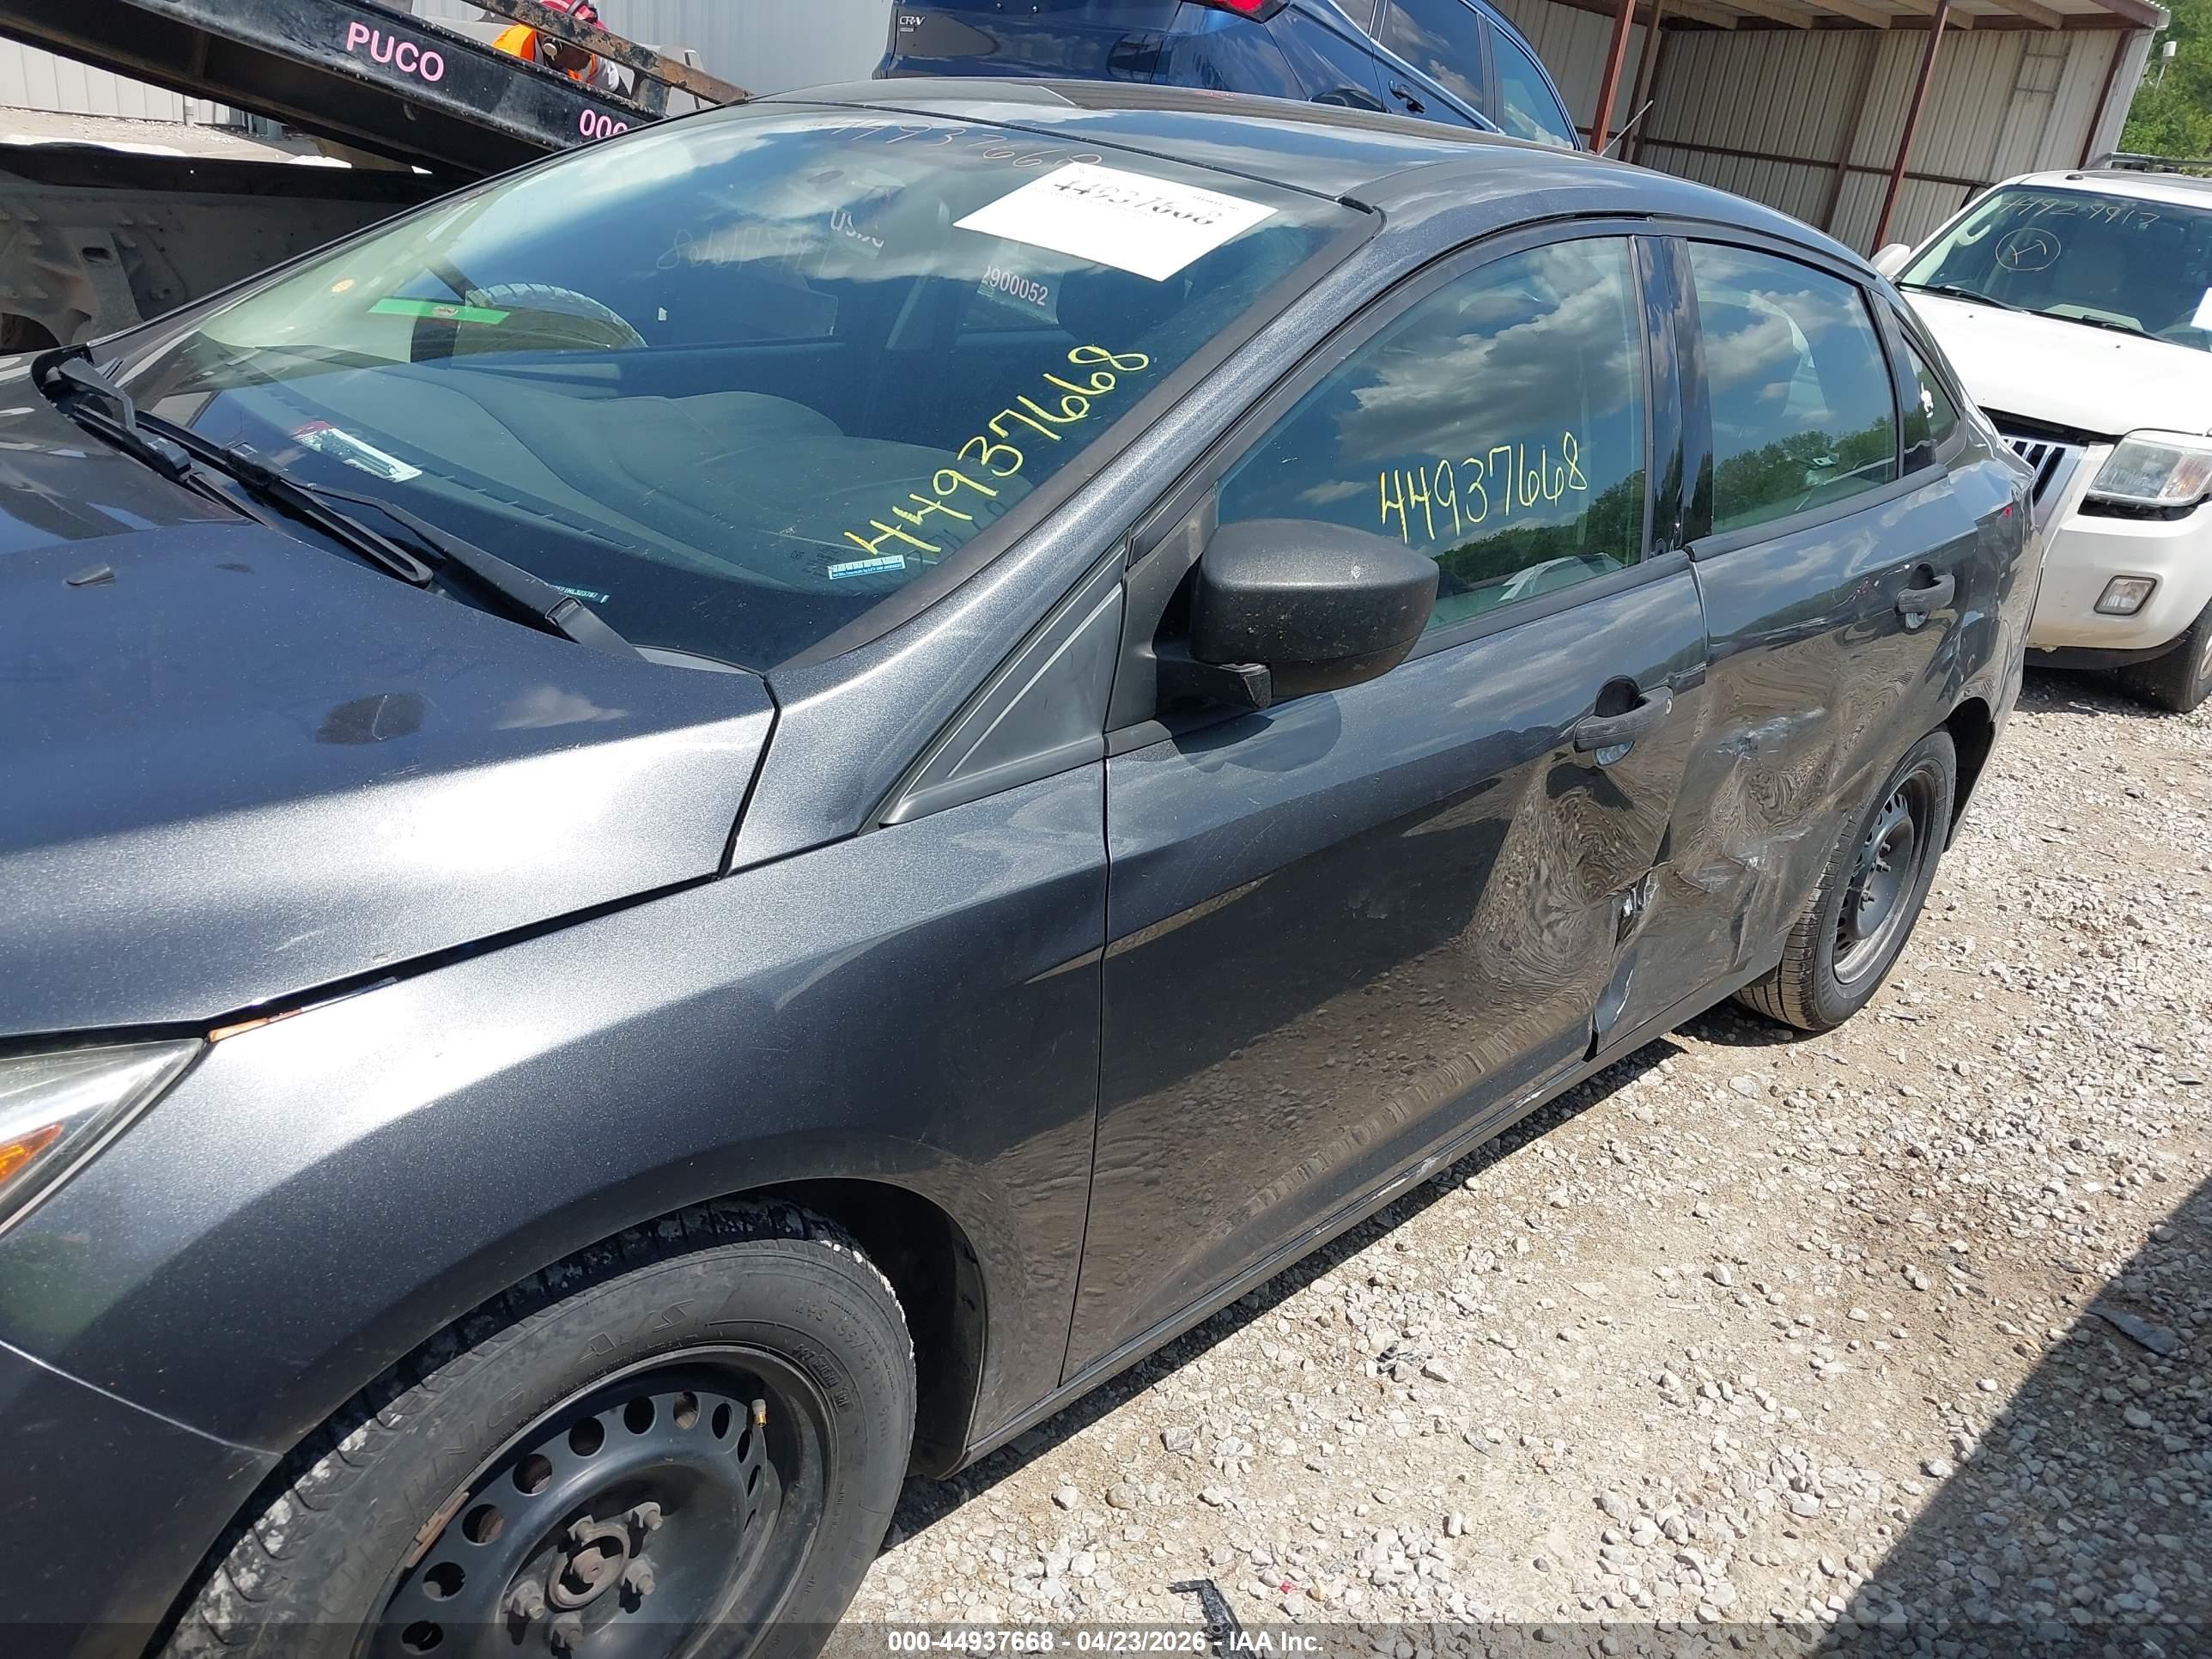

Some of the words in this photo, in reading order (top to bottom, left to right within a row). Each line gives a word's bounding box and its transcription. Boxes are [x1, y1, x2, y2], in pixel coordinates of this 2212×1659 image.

[346, 21, 445, 82] PUCO
[843, 344, 1151, 555] 44937668
[1380, 431, 1588, 545] 44937668
